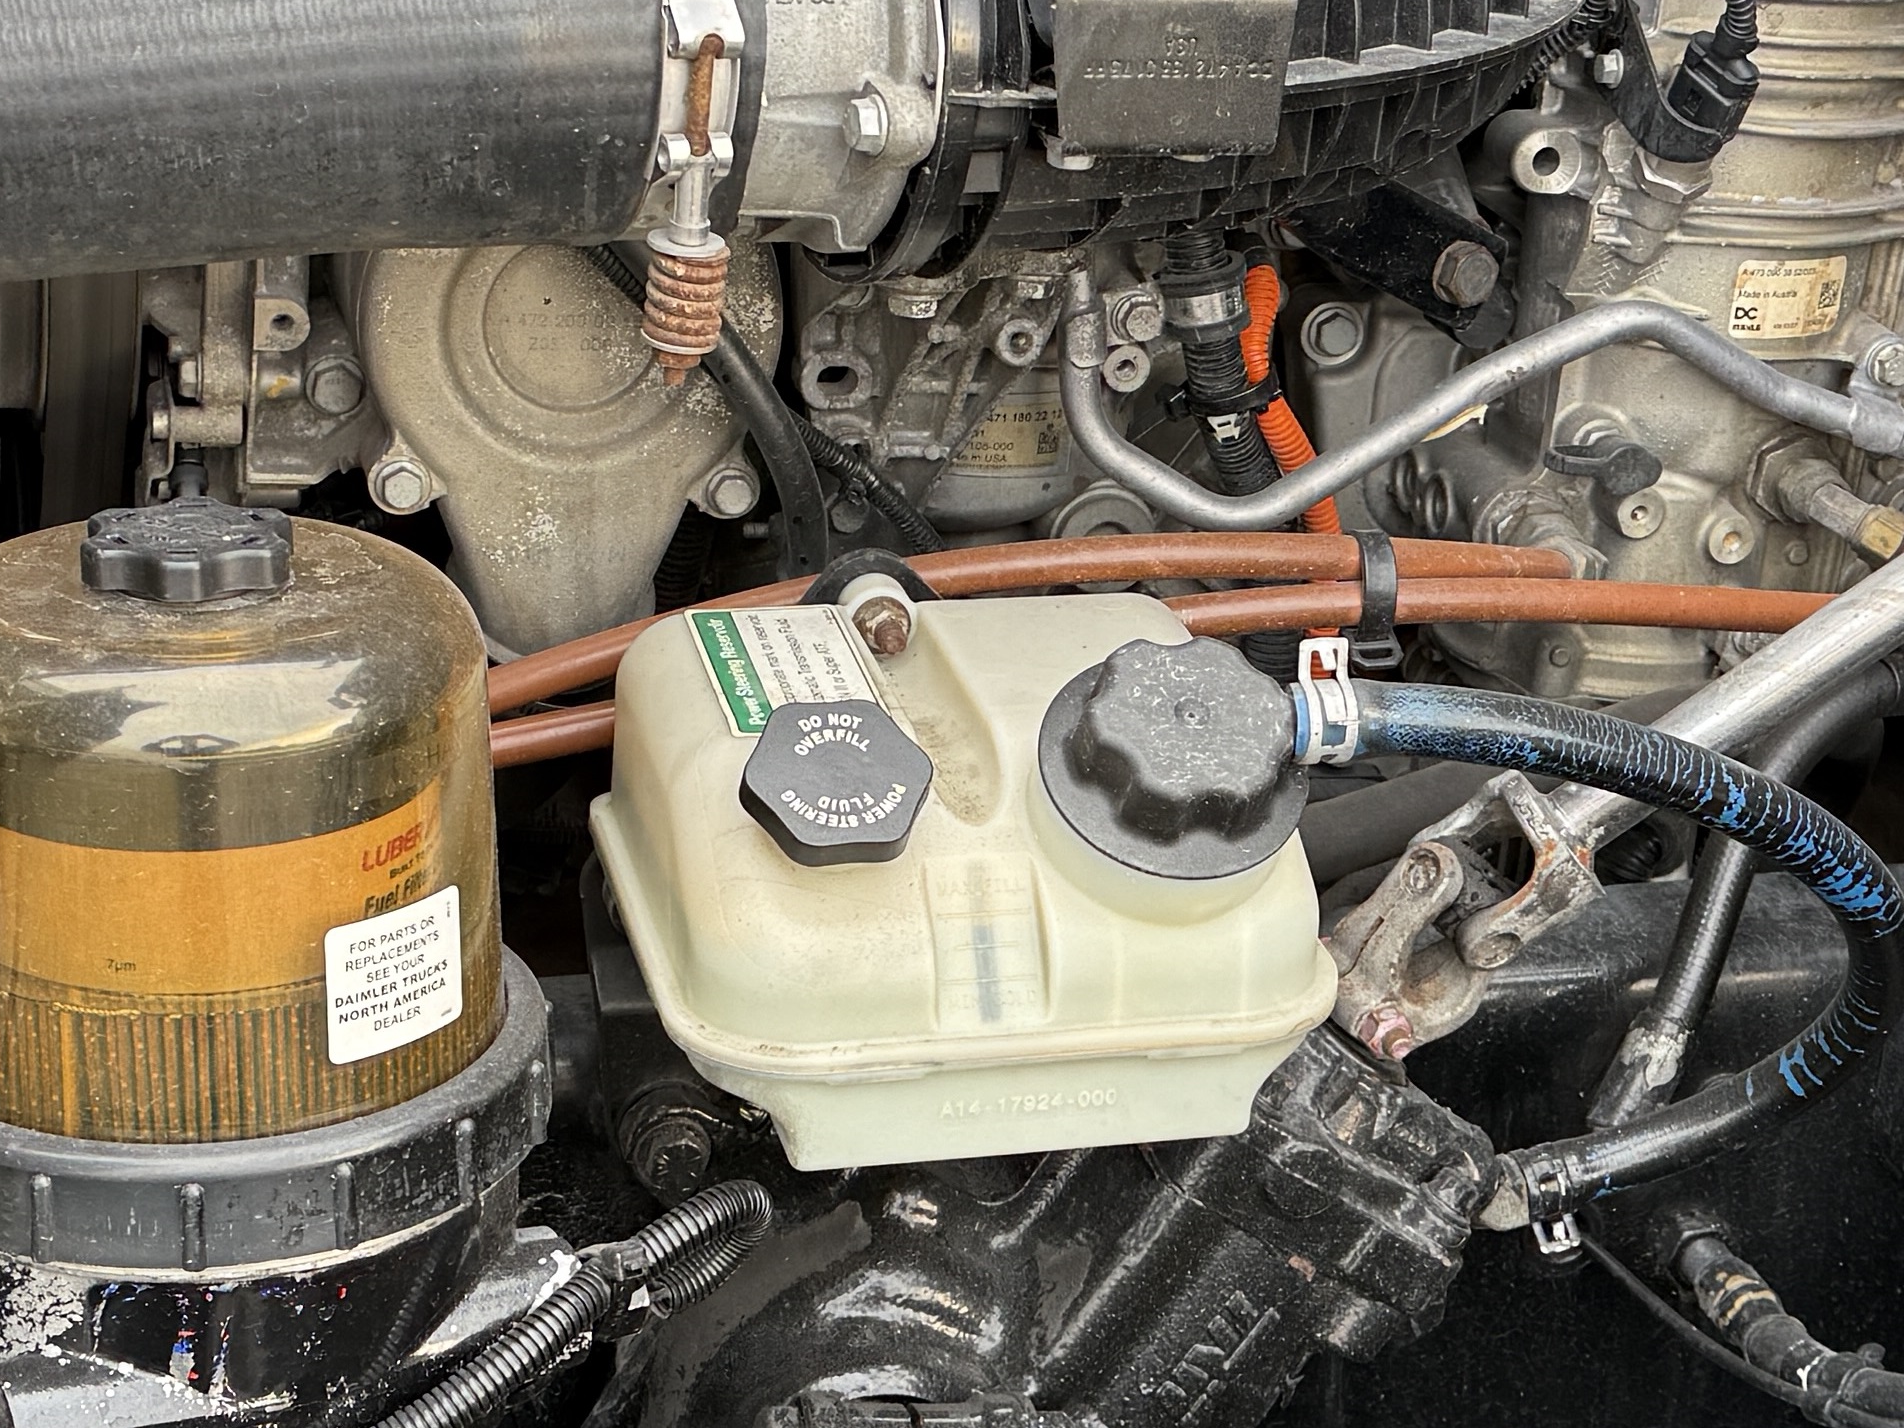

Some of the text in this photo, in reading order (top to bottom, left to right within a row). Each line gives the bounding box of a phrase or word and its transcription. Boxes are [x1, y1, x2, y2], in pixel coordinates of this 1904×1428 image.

[1738, 290, 1762, 299] Made
[1771, 290, 1798, 299] Austria
[1734, 306, 1759, 320] DC
[1013, 412, 1032, 423] 180
[984, 454, 1008, 463] USA
[727, 658, 755, 698] Steering
[742, 694, 767, 726] Power
[798, 712, 864, 733] DO NOT
[793, 728, 872, 757] OVERFILL
[779, 782, 908, 829] POWER STEERING
[816, 791, 876, 813] FLUID
[344, 929, 441, 972] REPLACEMENTS
[349, 915, 436, 956] FOR PARTS OR
[334, 958, 449, 1009] DAIMLER TRUCKS
[365, 954, 426, 985] SEE YOUR
[338, 976, 447, 1025] NORTH AMERICA
[373, 1005, 422, 1032] DEALER
[939, 1087, 1118, 1121] A14-17924-000
